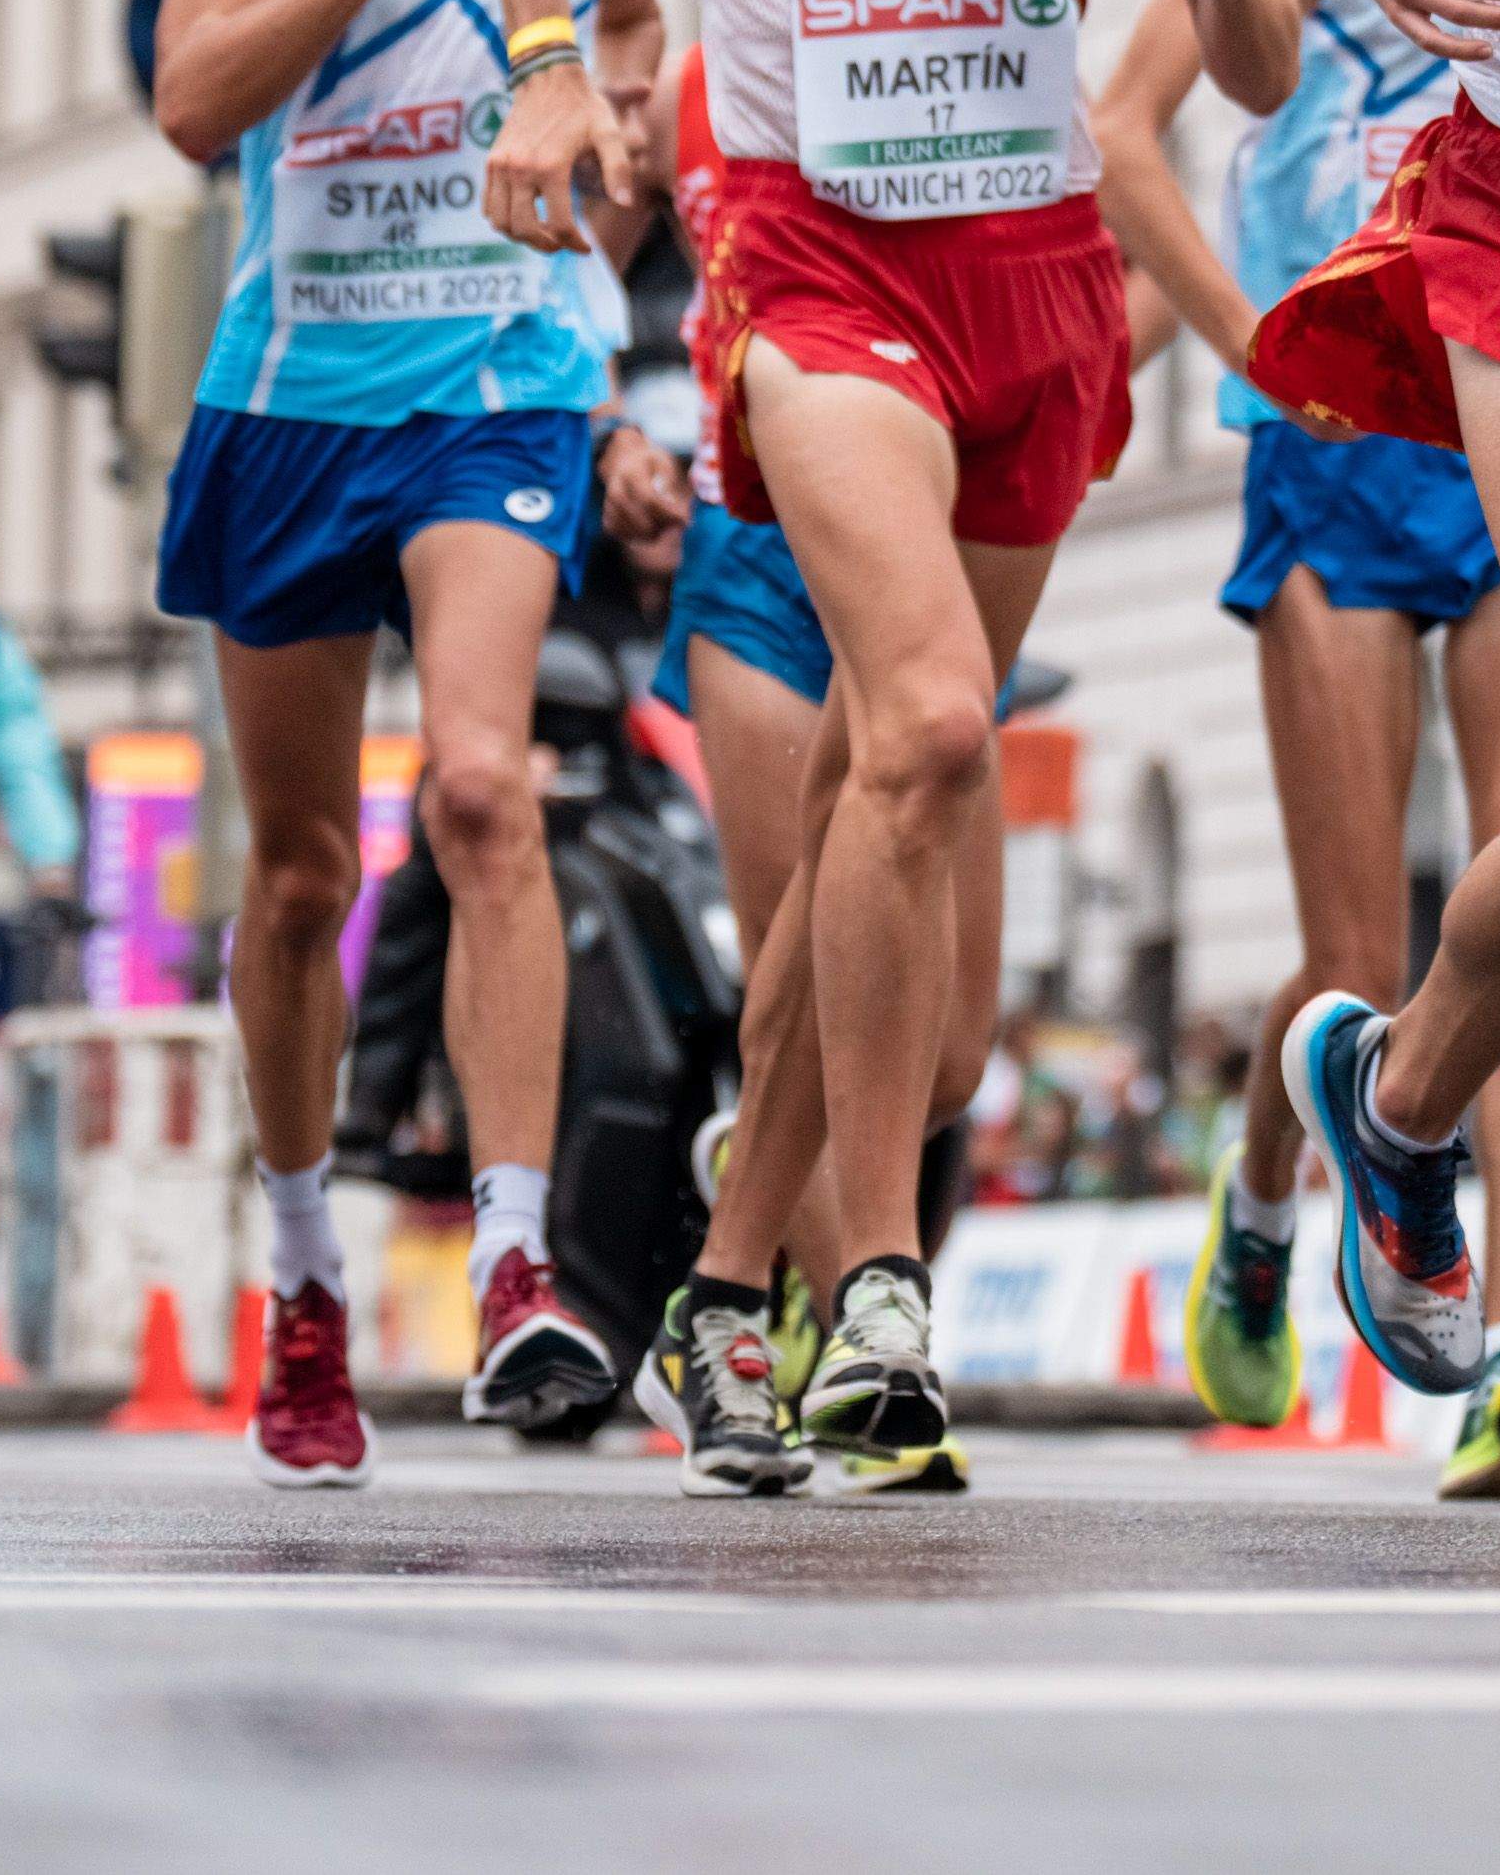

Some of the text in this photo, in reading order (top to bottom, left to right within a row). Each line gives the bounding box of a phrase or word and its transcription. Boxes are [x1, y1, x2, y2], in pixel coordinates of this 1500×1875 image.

[845, 43, 1027, 100] MARTÍN
[926, 103, 956, 132] 17
[883, 141, 934, 163] RUN
[326, 173, 476, 218] STANO
[821, 164, 1052, 209] MUNICH 2022
[289, 275, 524, 314] MUNICH 2022
